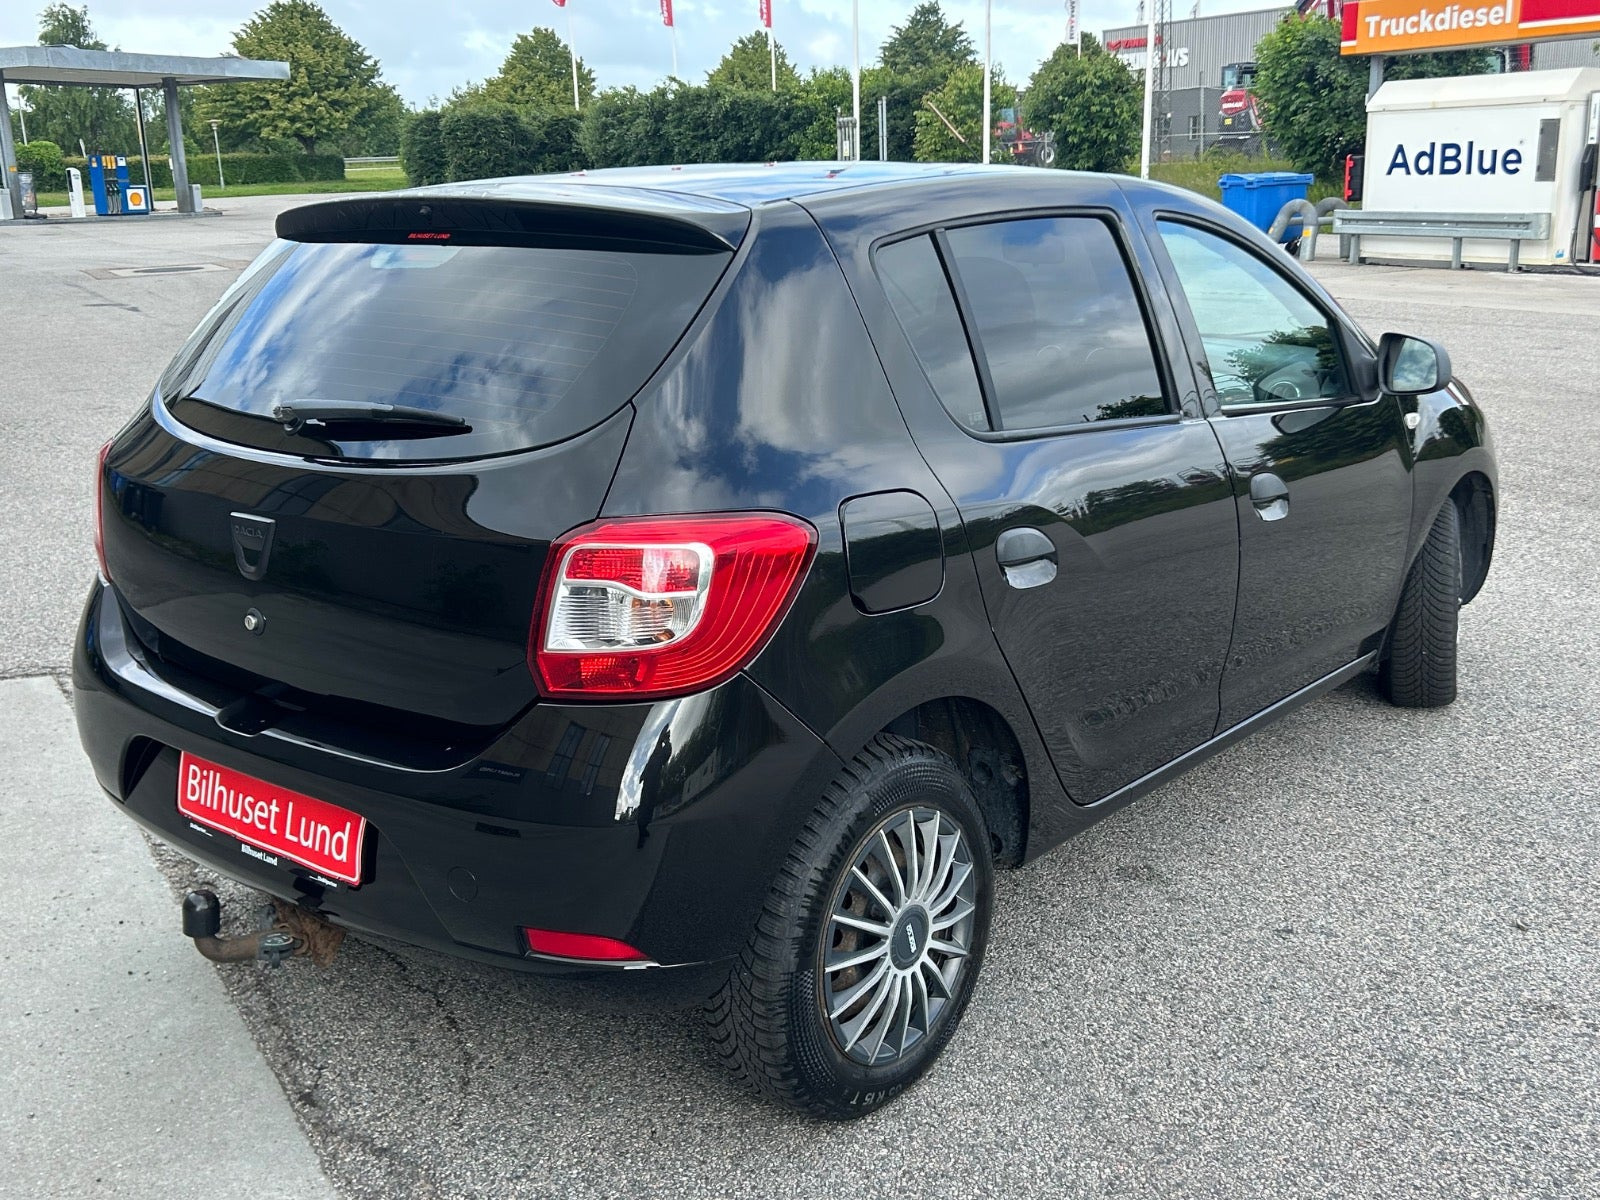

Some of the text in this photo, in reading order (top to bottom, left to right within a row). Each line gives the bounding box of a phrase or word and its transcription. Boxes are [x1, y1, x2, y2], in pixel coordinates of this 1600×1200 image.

[1365, 0, 1513, 38] Truckdiesel
[1386, 141, 1522, 176] AdBlue
[234, 525, 263, 538] DACIA
[186, 763, 351, 863] Bilhuset Lund
